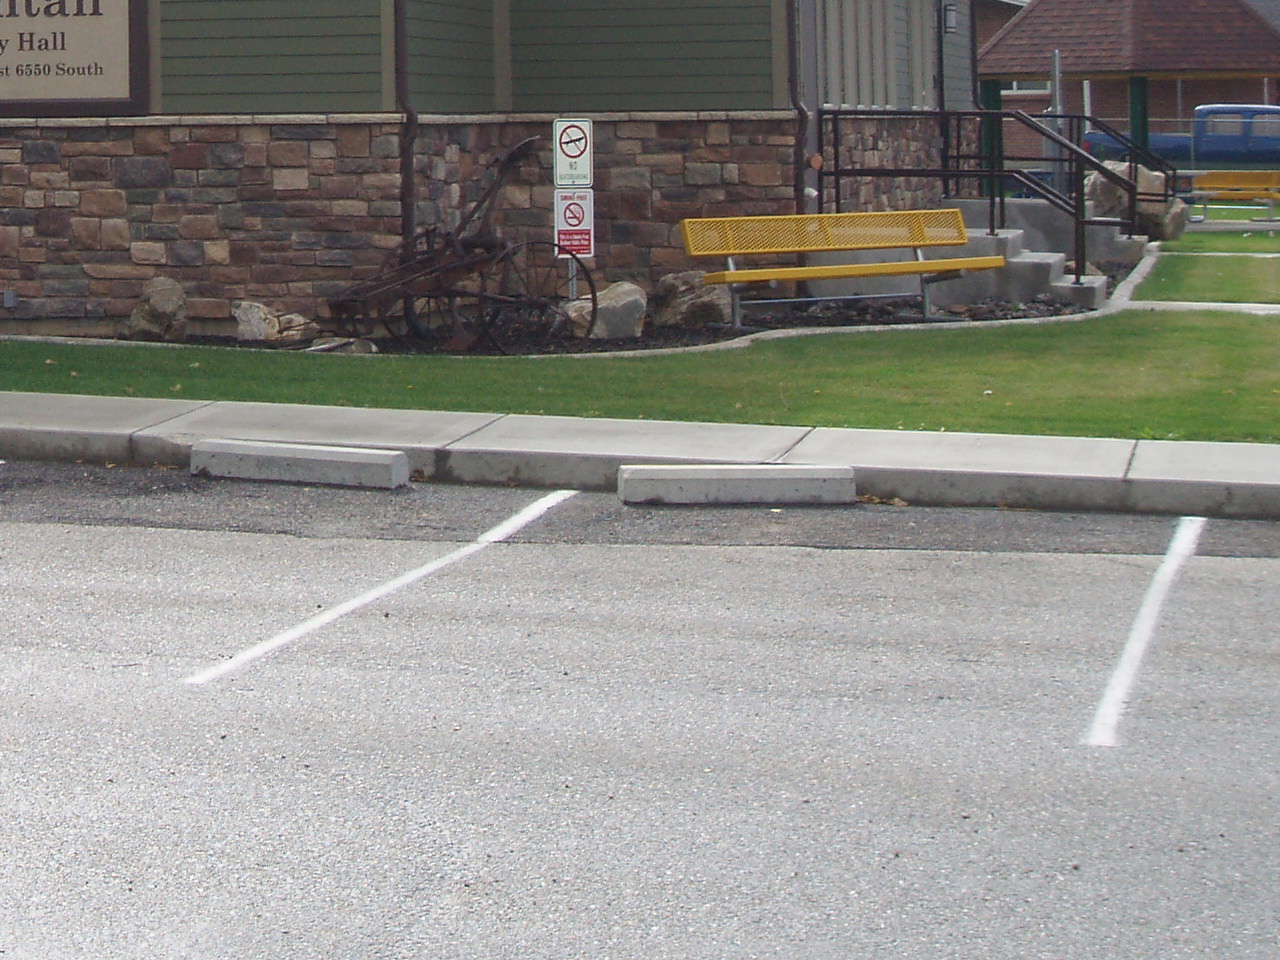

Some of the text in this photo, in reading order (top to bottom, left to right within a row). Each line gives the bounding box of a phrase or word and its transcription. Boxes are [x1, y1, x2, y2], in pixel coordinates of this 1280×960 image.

[17, 32, 67, 52] Hall
[15, 63, 51, 77] 6550
[55, 62, 104, 77] South
